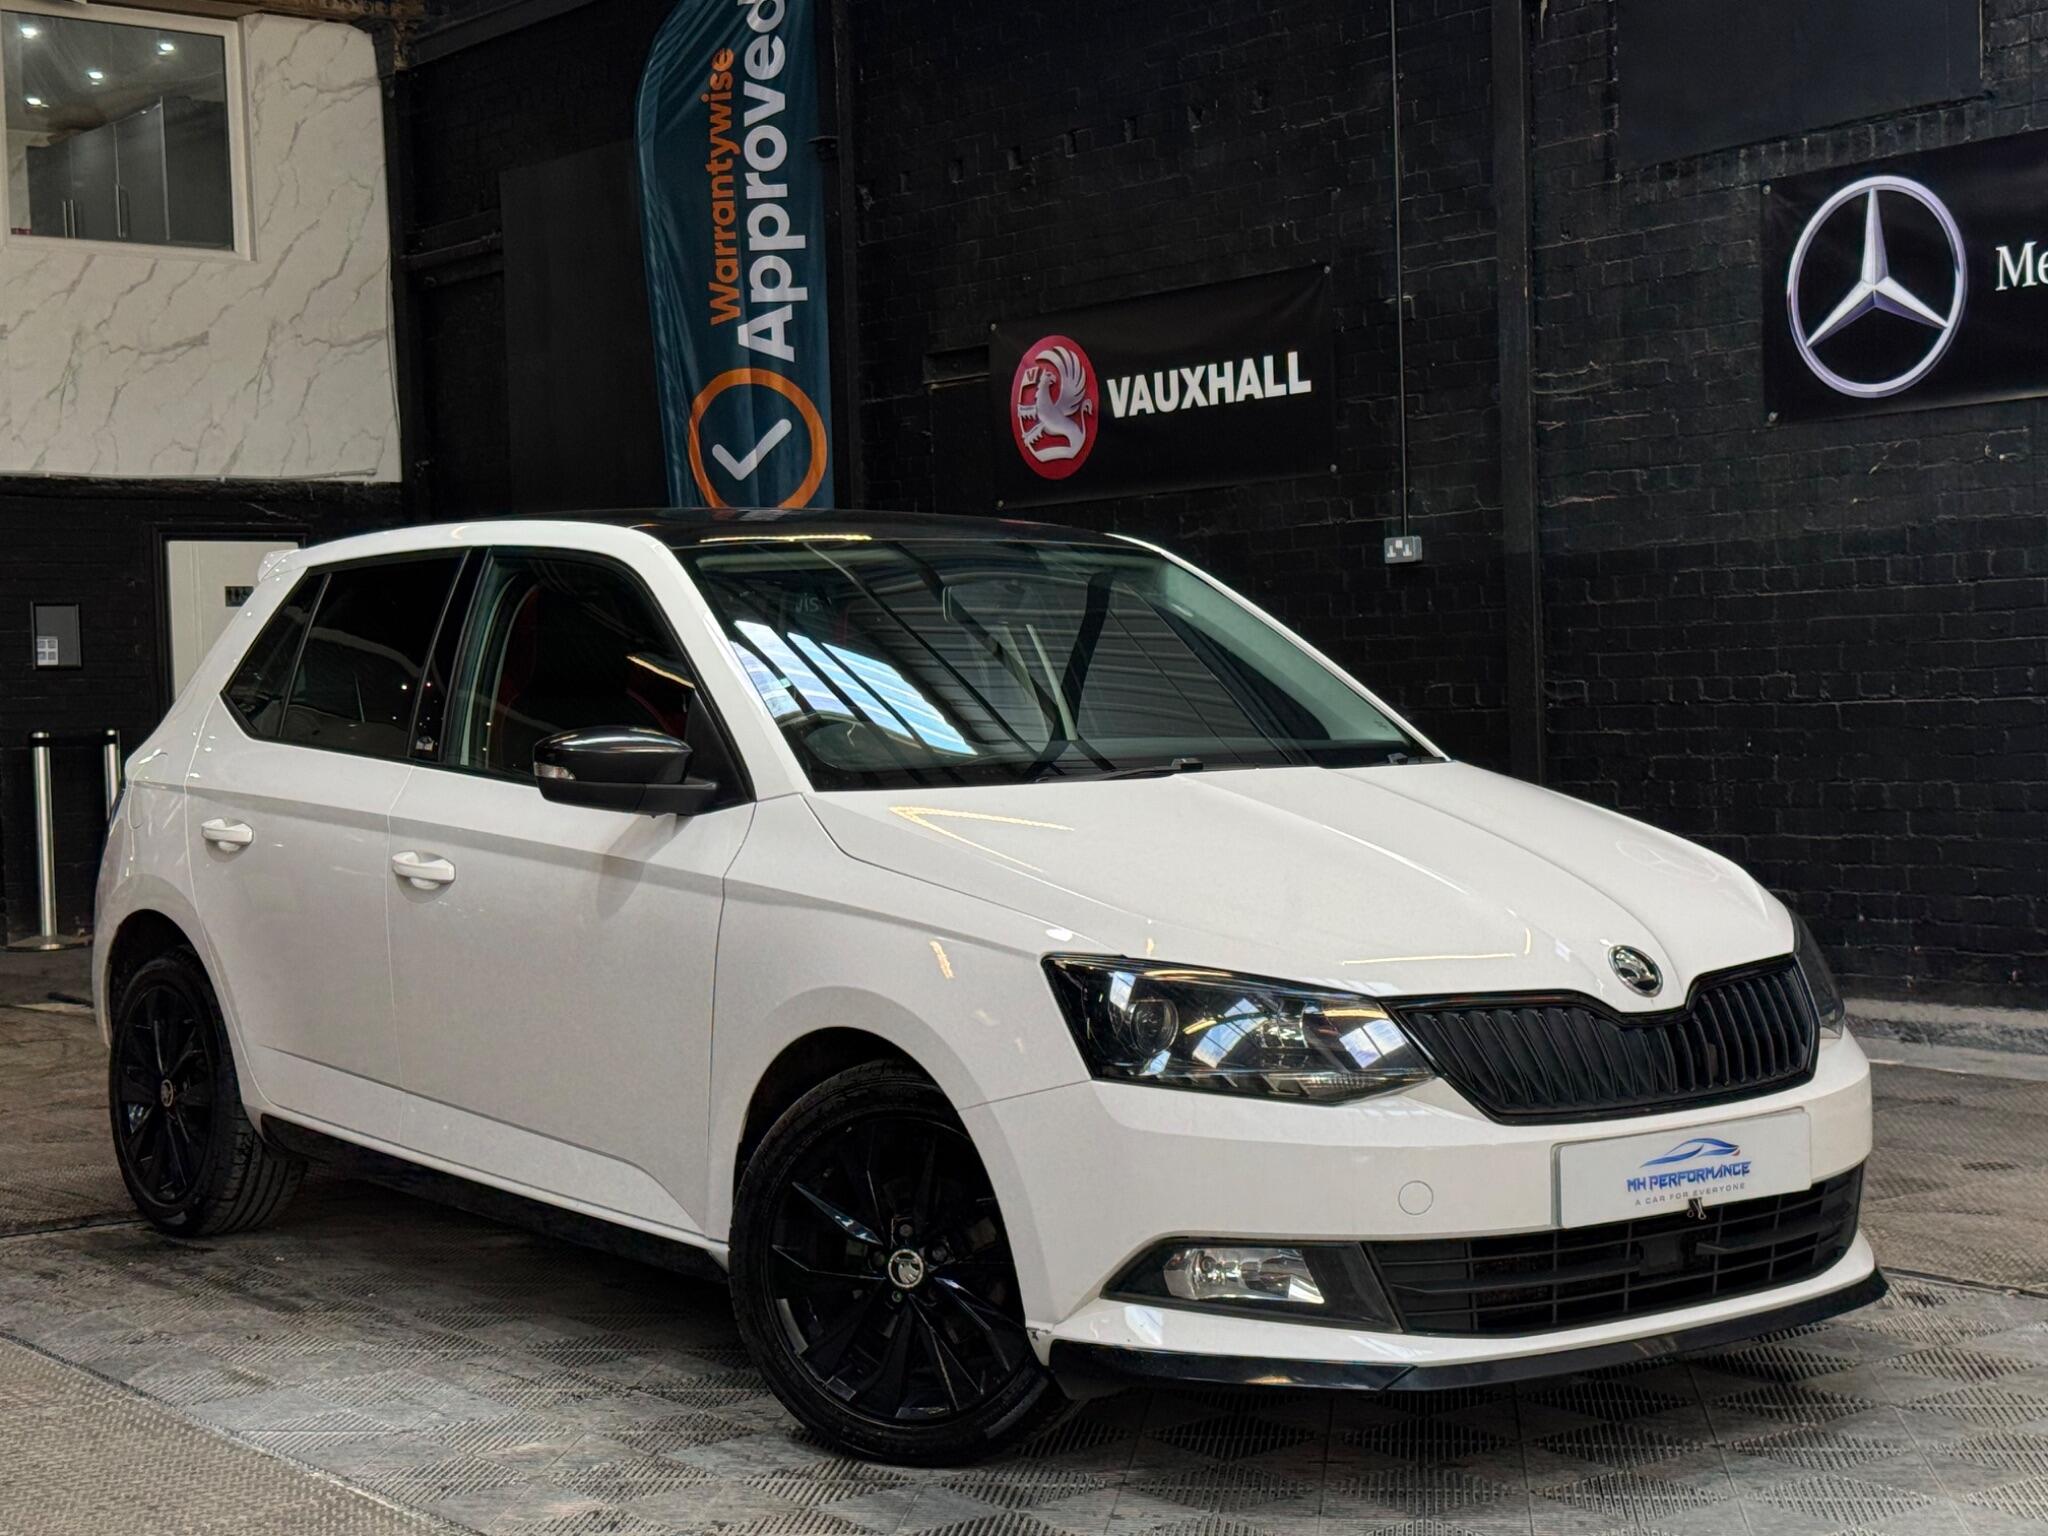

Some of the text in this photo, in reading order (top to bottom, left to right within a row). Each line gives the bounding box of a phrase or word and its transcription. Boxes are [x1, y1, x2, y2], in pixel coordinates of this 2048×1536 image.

[701, 48, 741, 326] Warrantywise
[737, 0, 808, 362] Approved
[1106, 351, 1312, 418] VAUXHALL
[1626, 1161, 1752, 1192] MH PERFORMANCE
[1645, 1195, 1665, 1205] CAR
[1670, 1191, 1689, 1200] FOR
[1692, 1182, 1746, 1197] EVERYONE
